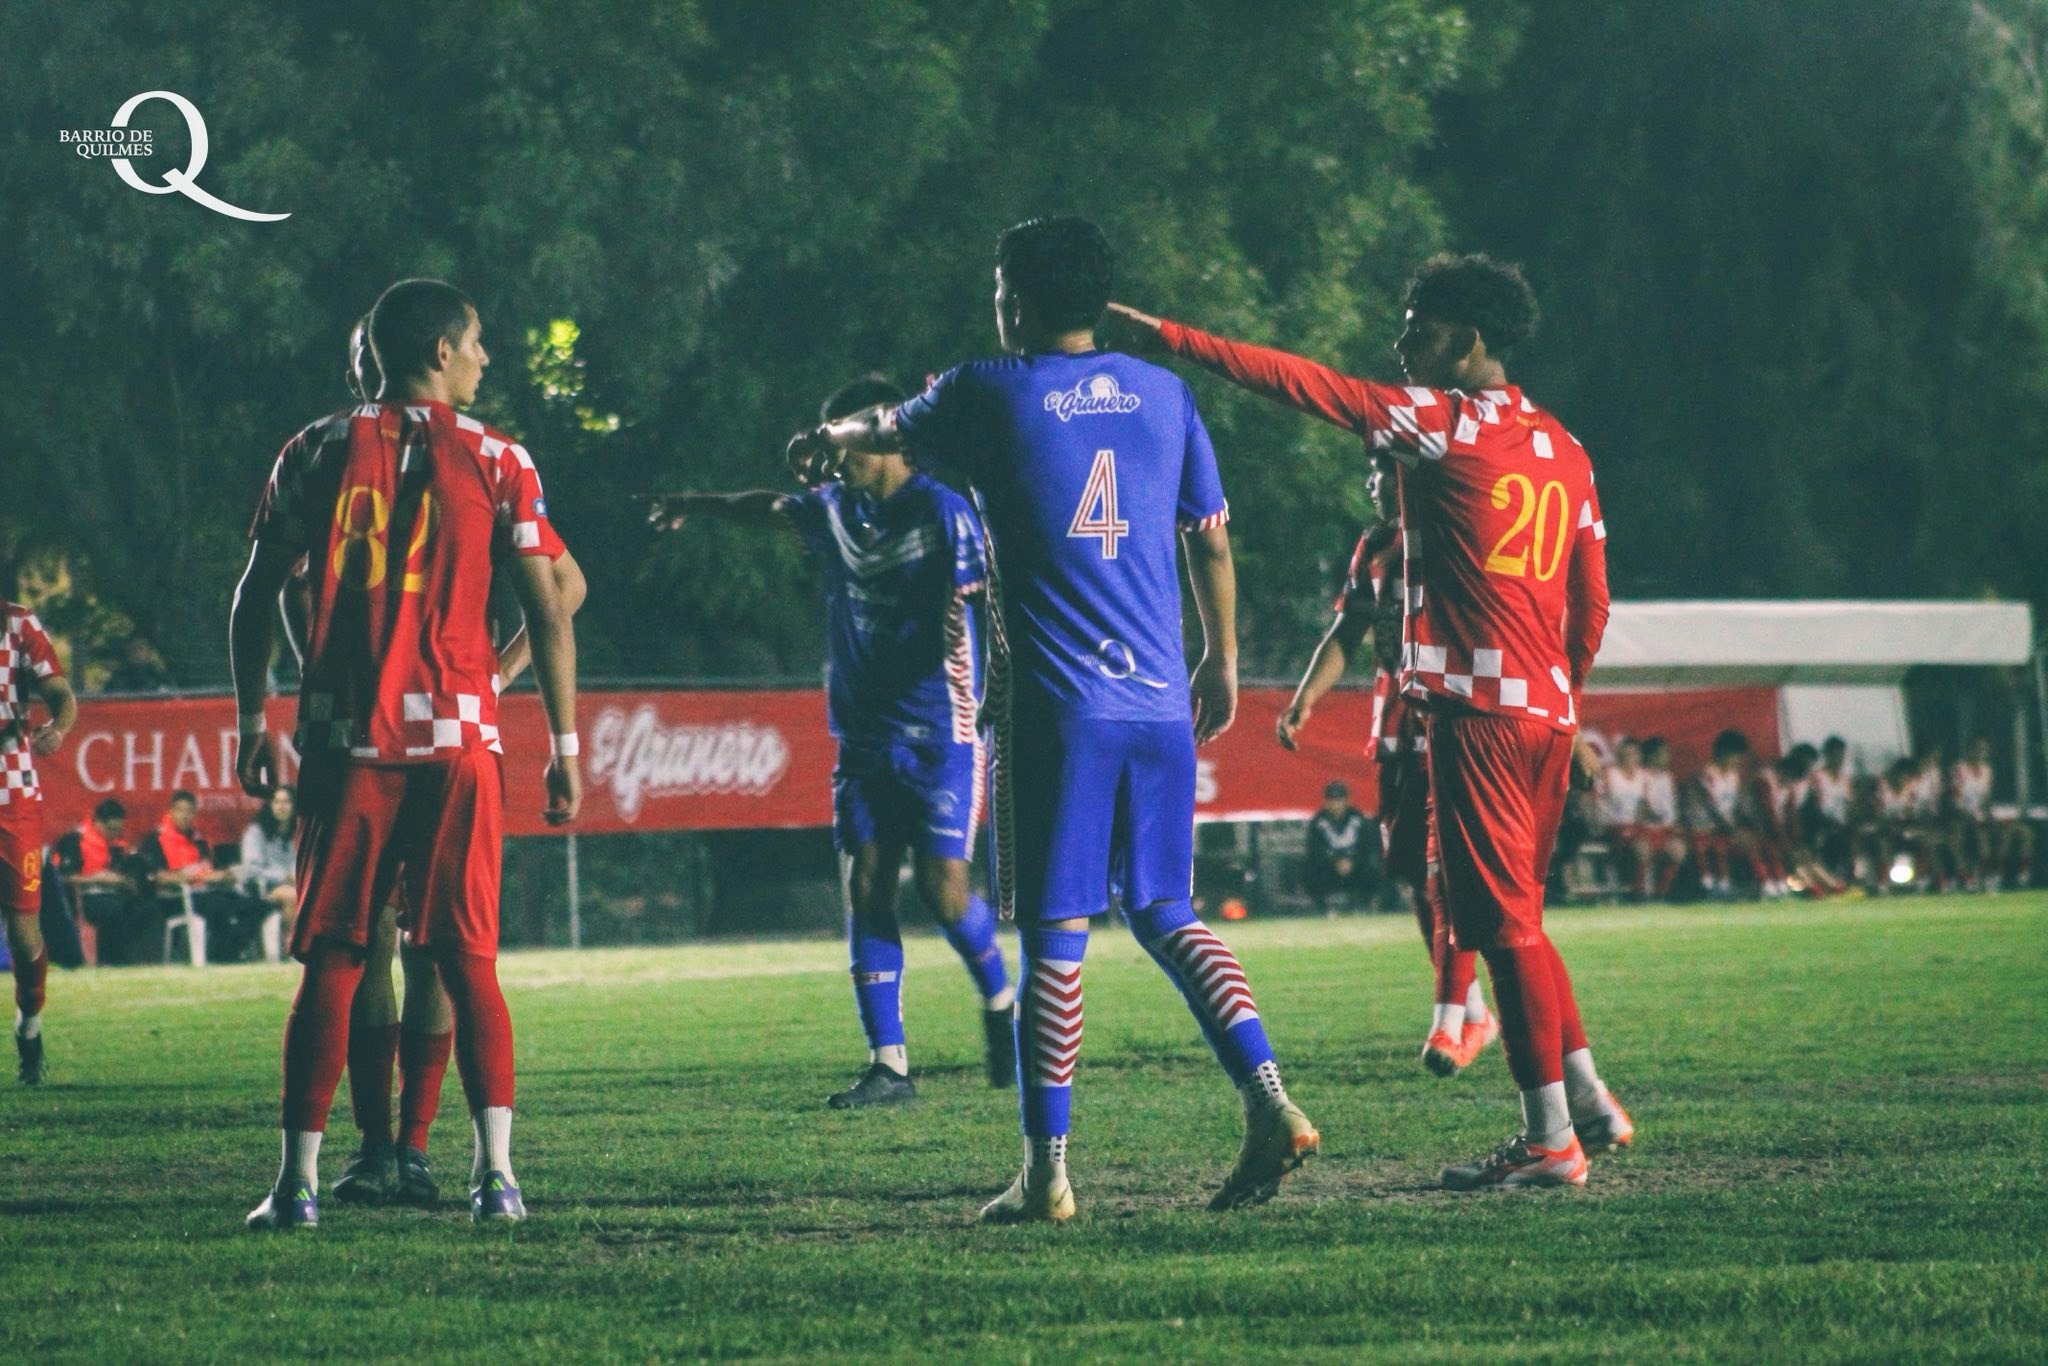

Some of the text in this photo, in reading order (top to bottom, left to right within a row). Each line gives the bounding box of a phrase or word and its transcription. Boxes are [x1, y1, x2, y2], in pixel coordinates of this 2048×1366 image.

[1056, 390, 1140, 422] Granero
[1066, 449, 1129, 560] 4
[1484, 473, 1569, 582] 20
[613, 702, 788, 822] Granero
